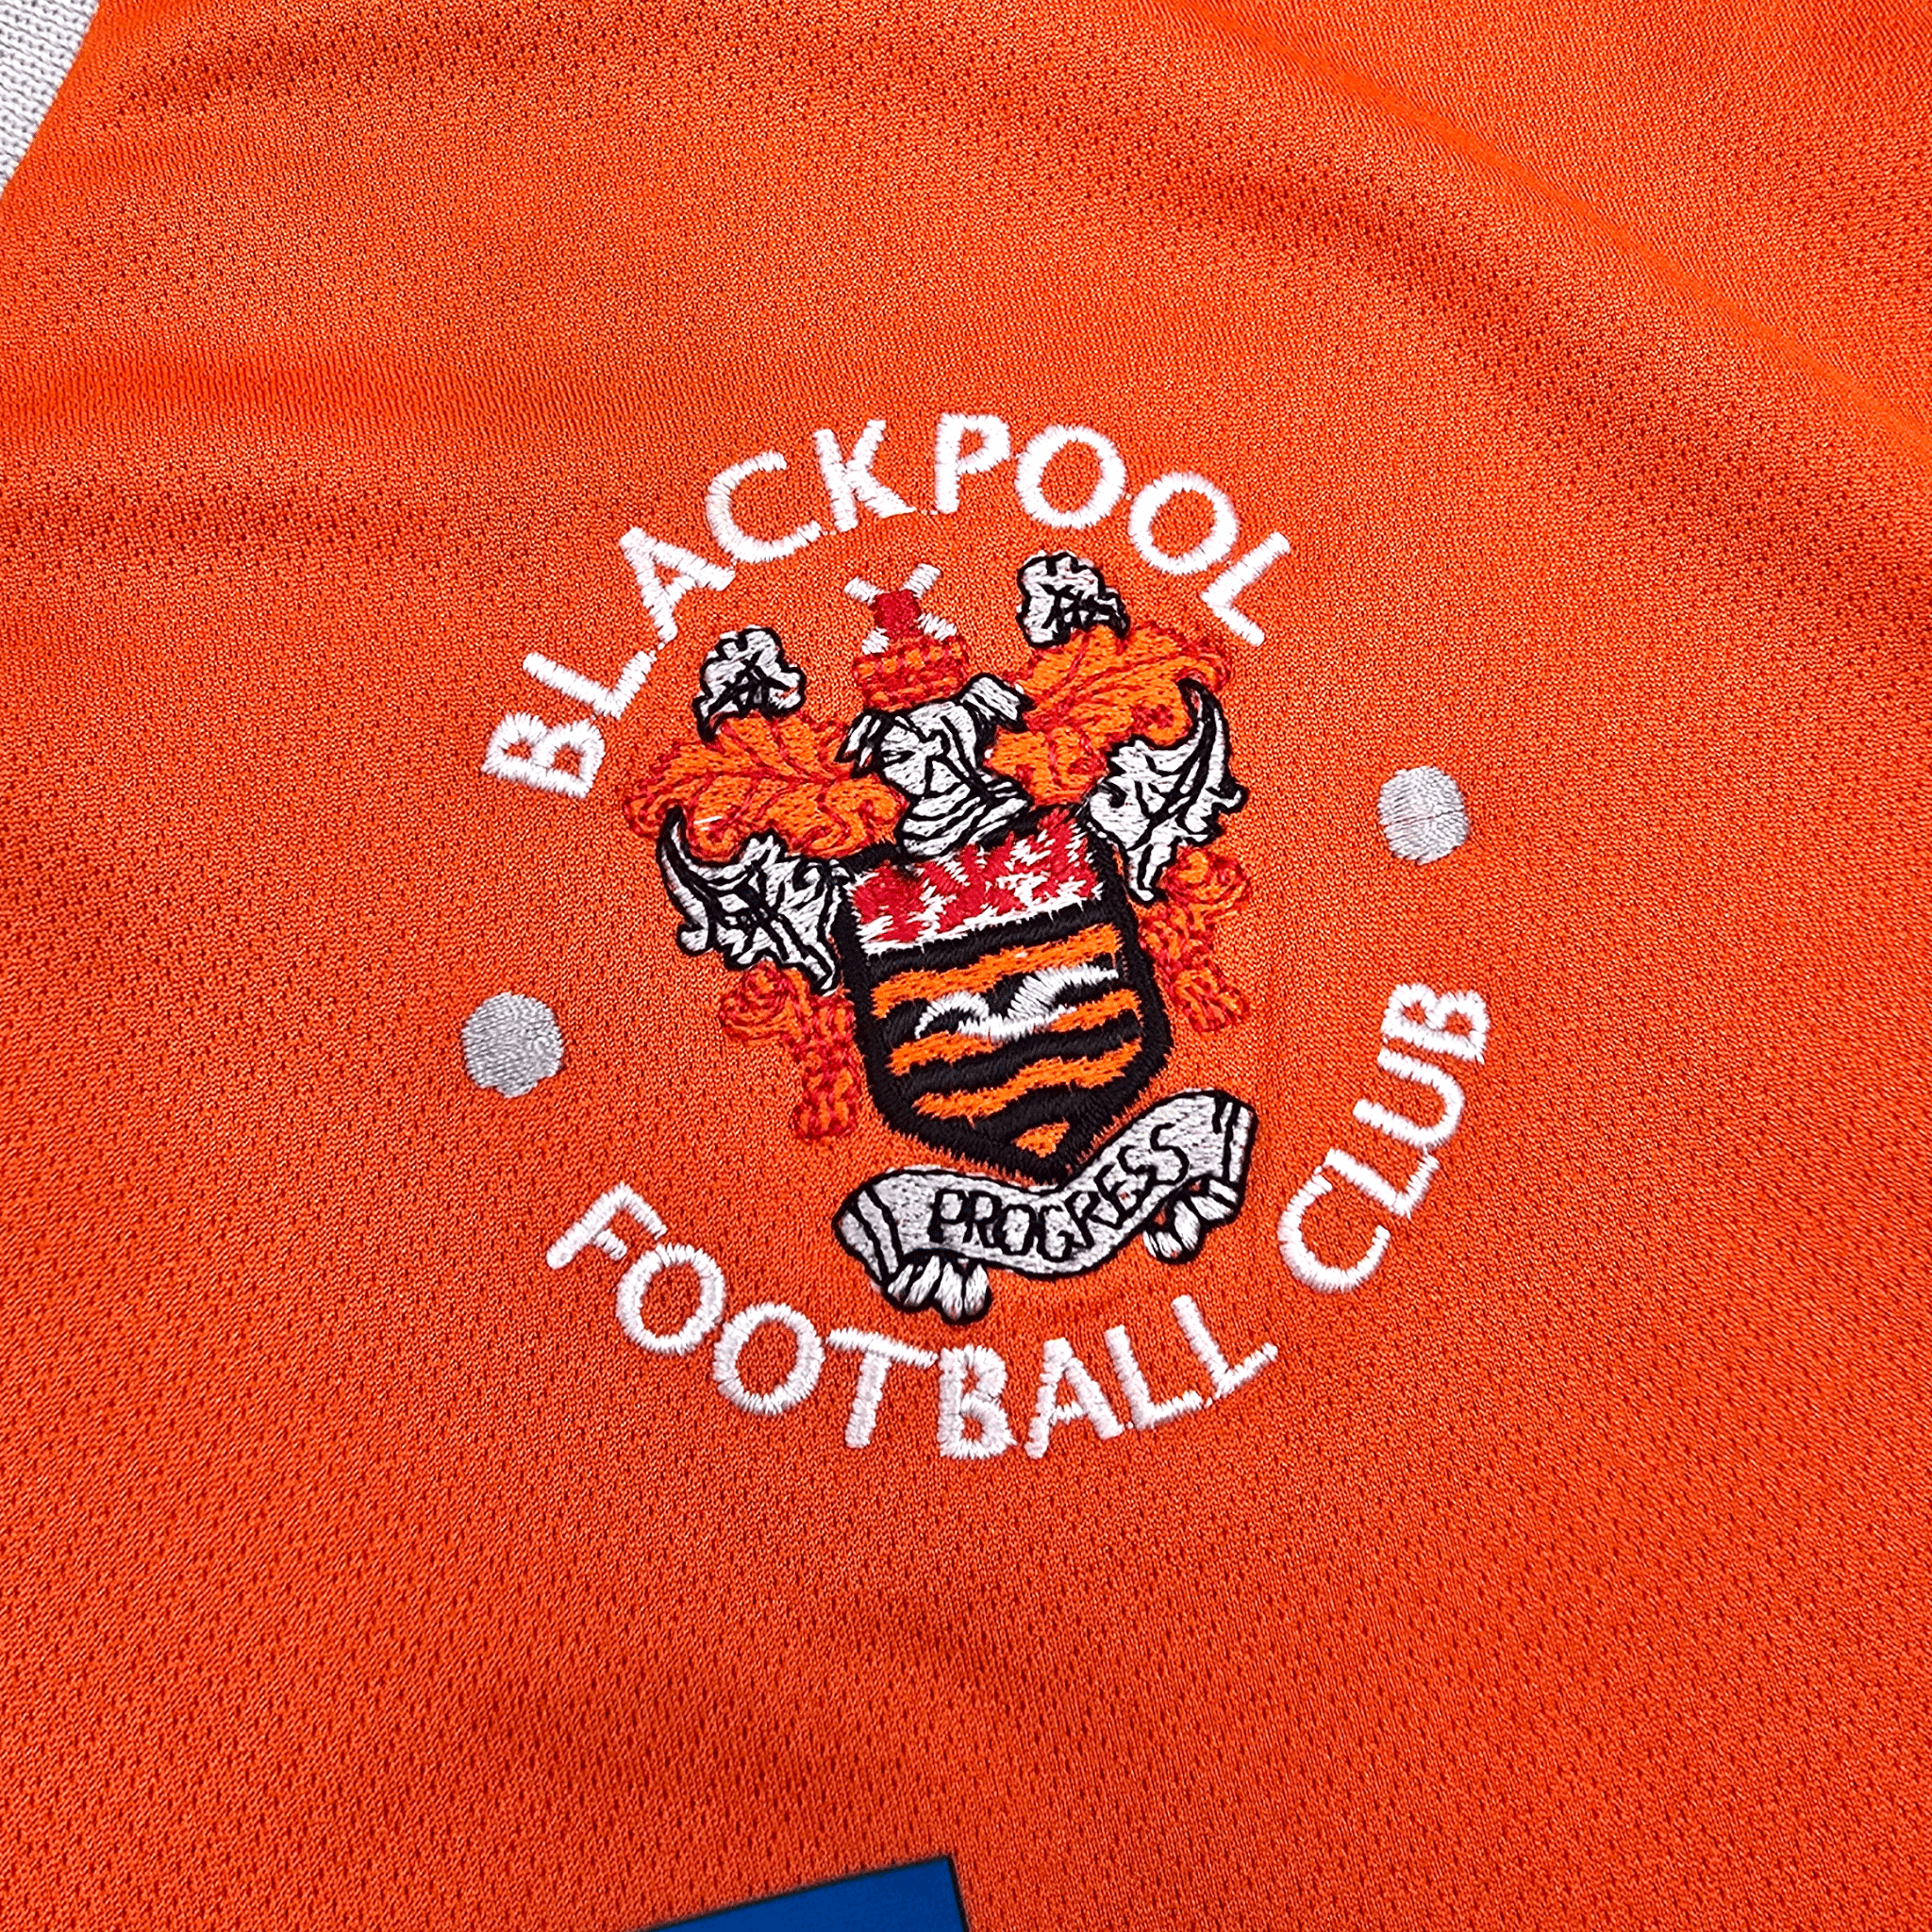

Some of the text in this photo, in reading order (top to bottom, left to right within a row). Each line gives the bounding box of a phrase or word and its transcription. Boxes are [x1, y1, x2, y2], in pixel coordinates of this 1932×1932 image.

[480, 412, 1293, 799] BLACKPOOL
[545, 982, 1491, 1461] FOOTBALL CLUB
[927, 1122, 1191, 1262] PROGRESS
